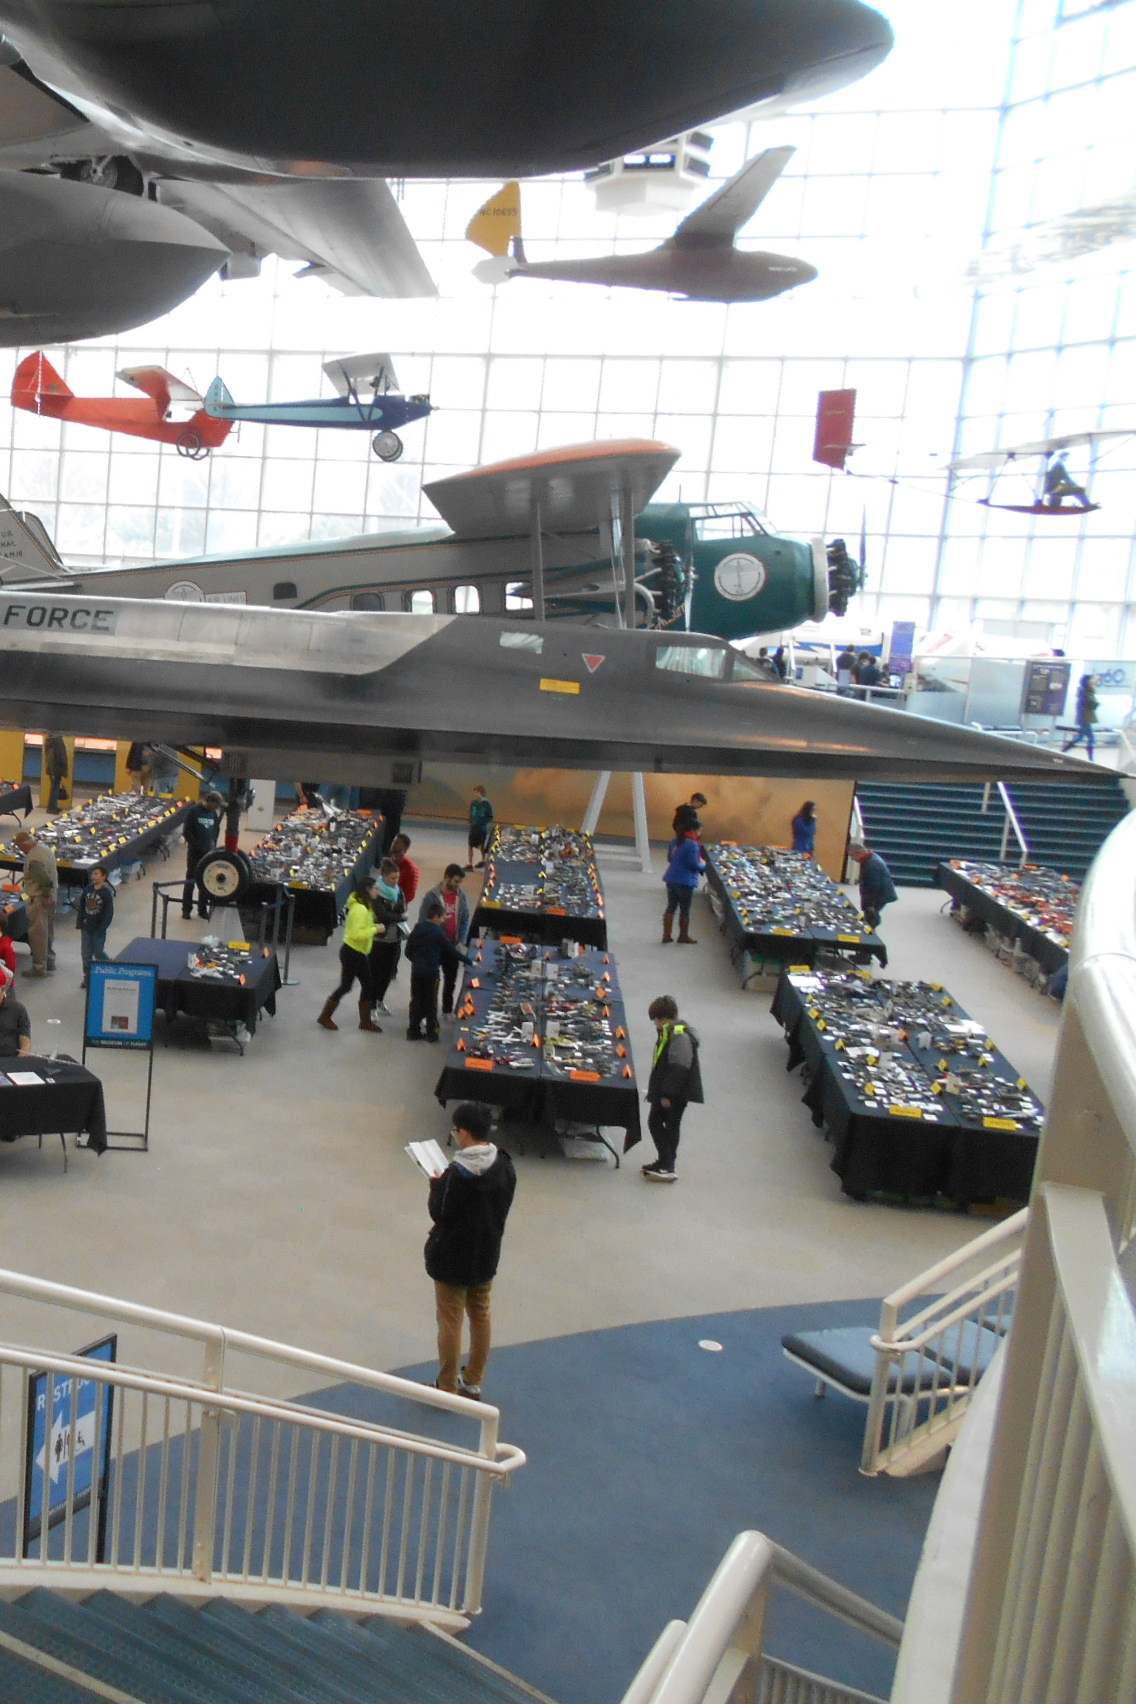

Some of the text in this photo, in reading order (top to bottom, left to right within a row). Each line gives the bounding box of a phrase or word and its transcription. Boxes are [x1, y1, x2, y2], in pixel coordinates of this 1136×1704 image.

[3, 605, 114, 632] FORCE
[95, 966, 152, 977] Public Programs
